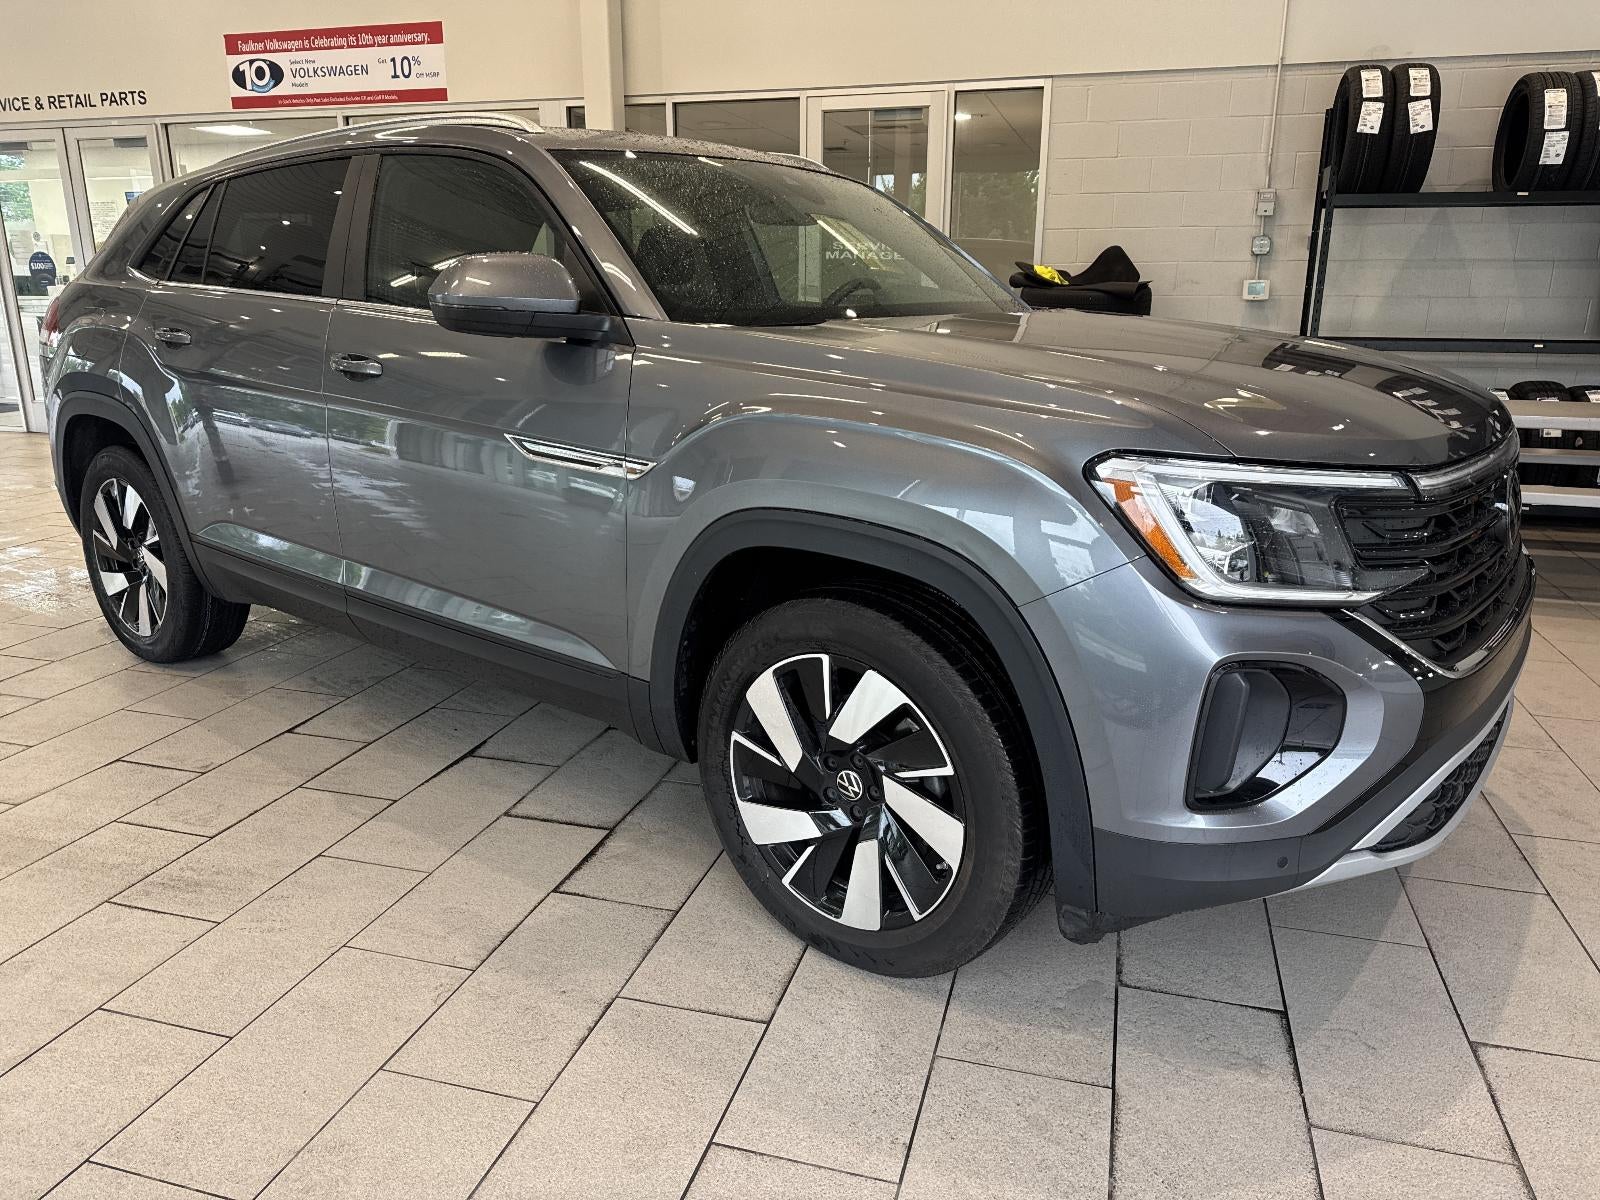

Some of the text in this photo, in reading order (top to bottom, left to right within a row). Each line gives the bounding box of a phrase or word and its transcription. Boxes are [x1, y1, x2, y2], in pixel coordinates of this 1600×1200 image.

[237, 40, 265, 52] Faulkner
[265, 38, 303, 51] Volkswagen
[304, 36, 309, 48] is
[310, 34, 347, 49] Celebrating
[358, 32, 374, 45] 10th
[374, 34, 388, 47] year
[389, 30, 430, 45] anniversary.
[238, 60, 271, 91] 10
[290, 64, 369, 78] VOLKSWAGEN
[0, 90, 147, 112] VICE & RETAIL PARTS
